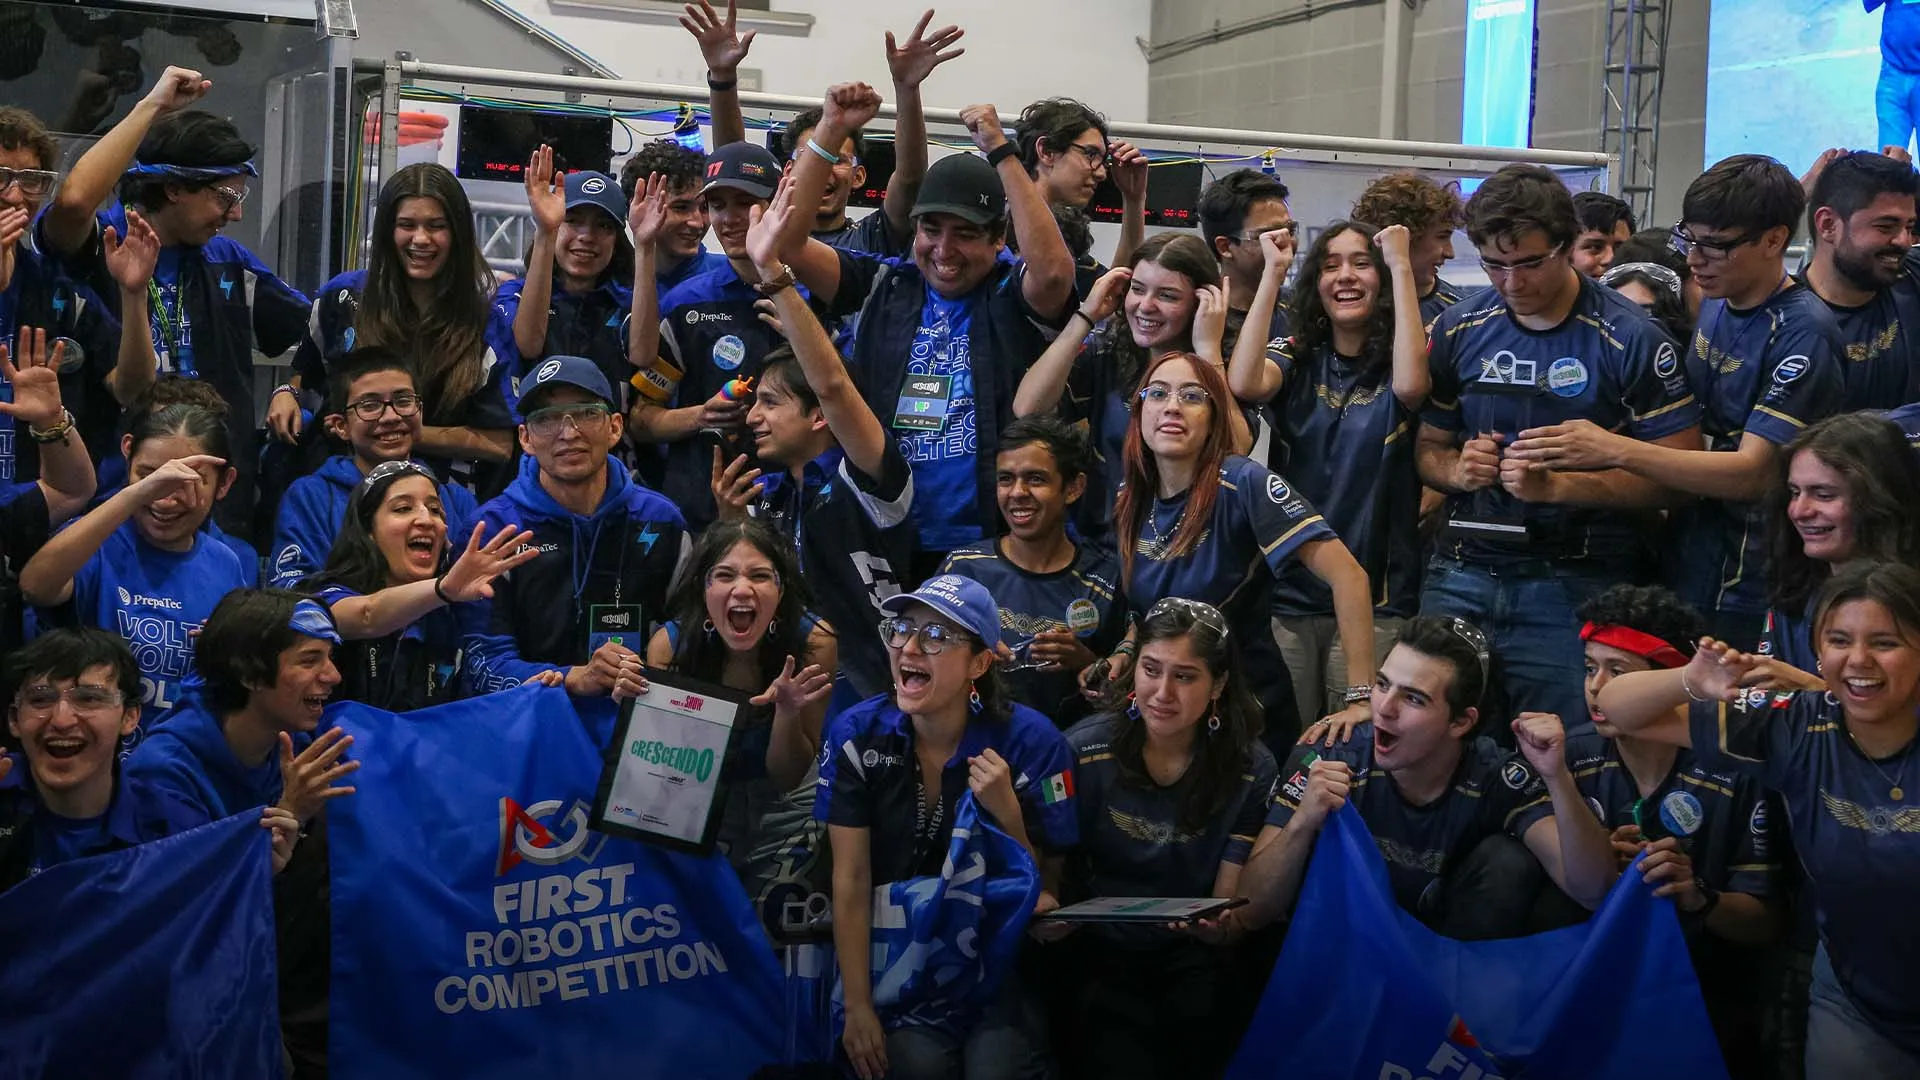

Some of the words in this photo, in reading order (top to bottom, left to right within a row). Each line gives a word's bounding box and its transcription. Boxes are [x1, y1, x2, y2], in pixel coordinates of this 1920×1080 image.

[700, 312, 733, 322] PrepaTec
[133, 594, 183, 610] PrepaTec
[631, 740, 714, 783] CRESCENDO
[494, 862, 635, 925] FIRST
[465, 903, 681, 968] ROBOTICS
[434, 940, 729, 1014] COMPETITION
